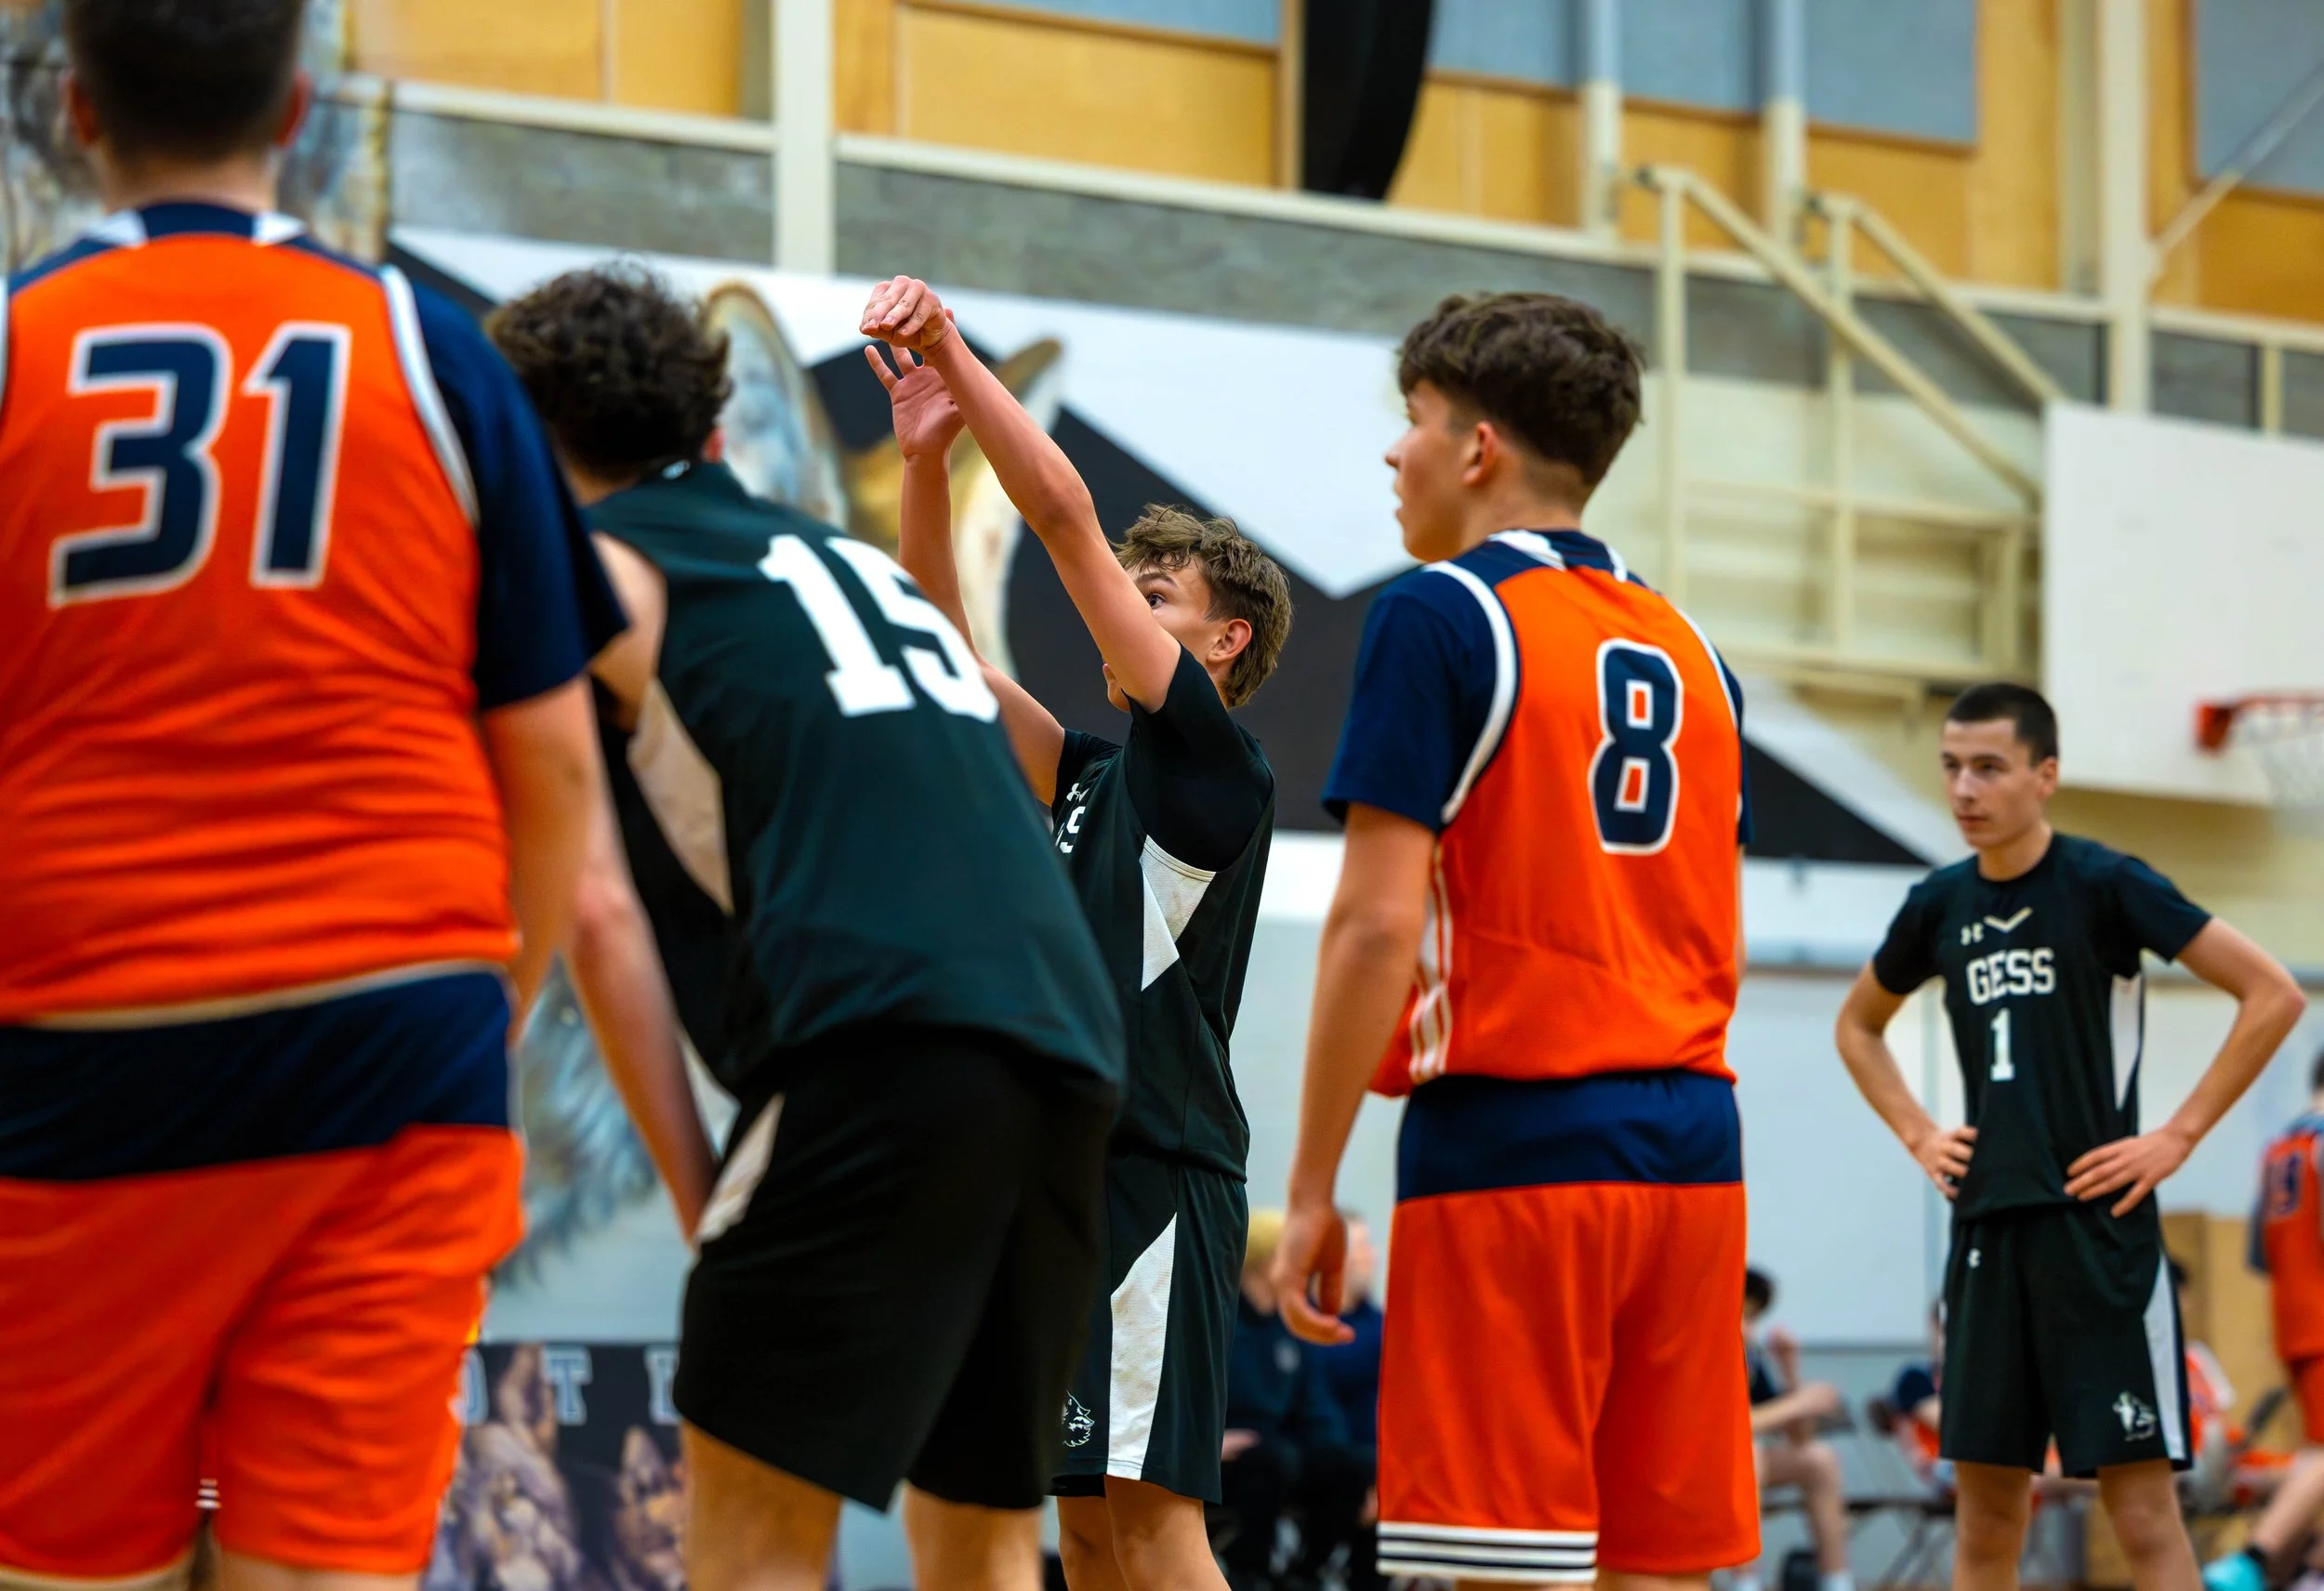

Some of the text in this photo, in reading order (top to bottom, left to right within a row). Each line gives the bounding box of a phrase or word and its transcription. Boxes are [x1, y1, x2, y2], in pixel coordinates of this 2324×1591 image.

[48, 320, 351, 610] 31
[757, 533, 999, 723] 15
[1587, 638, 1684, 856] 8
[1966, 947, 2056, 1006] GESS
[1990, 1007, 2015, 1082] 1
